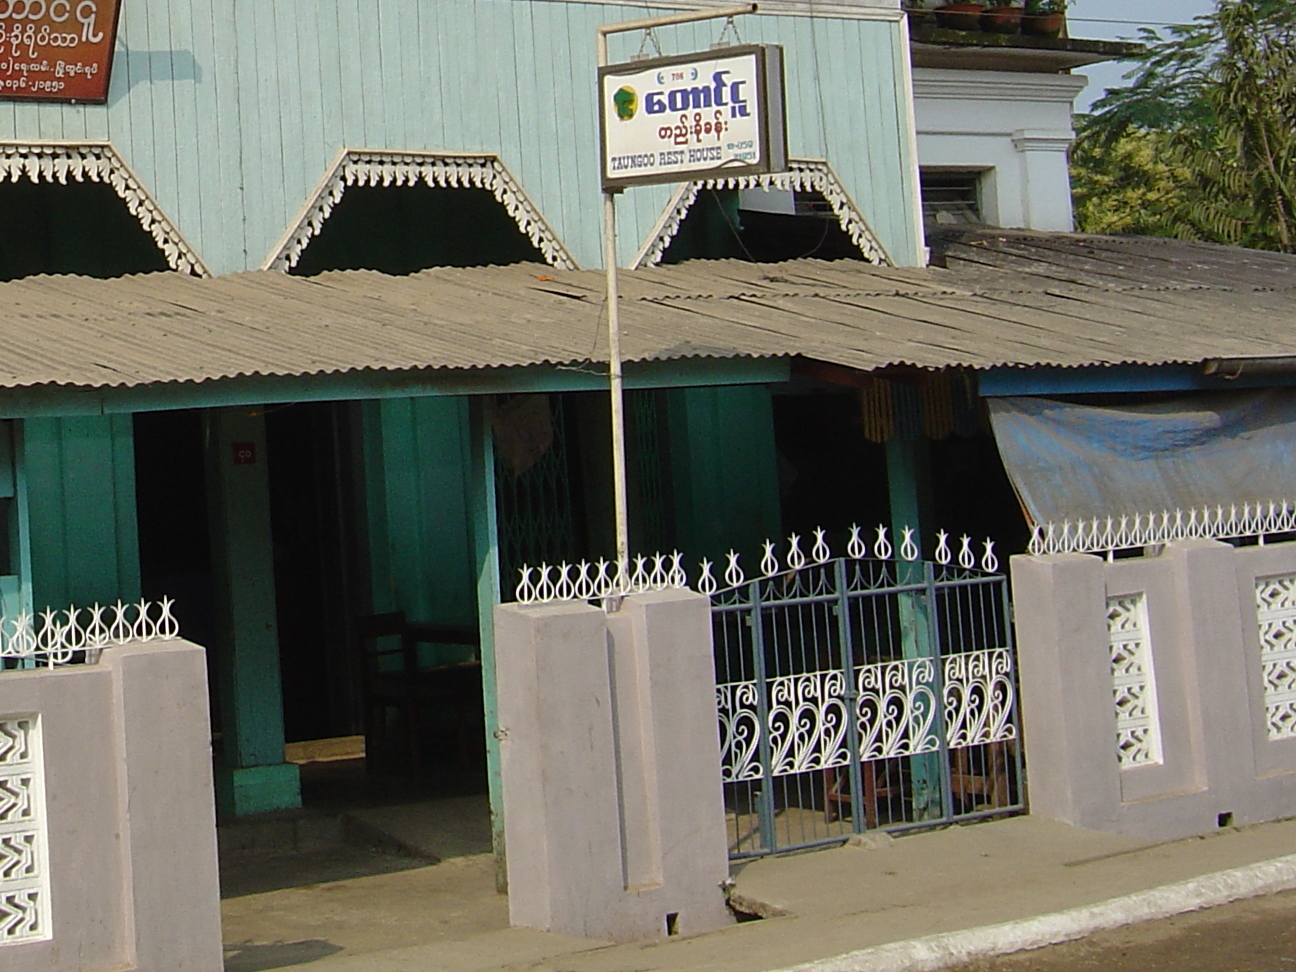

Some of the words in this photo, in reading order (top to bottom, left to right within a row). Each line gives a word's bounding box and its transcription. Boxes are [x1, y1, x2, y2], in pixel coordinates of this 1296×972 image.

[645, 70, 751, 118] တောင်ငူ
[658, 110, 729, 145] တည်းခိုခန်း
[611, 153, 655, 170] TAUNGOO
[659, 150, 685, 166] REST
[688, 146, 722, 163] HOUSE
